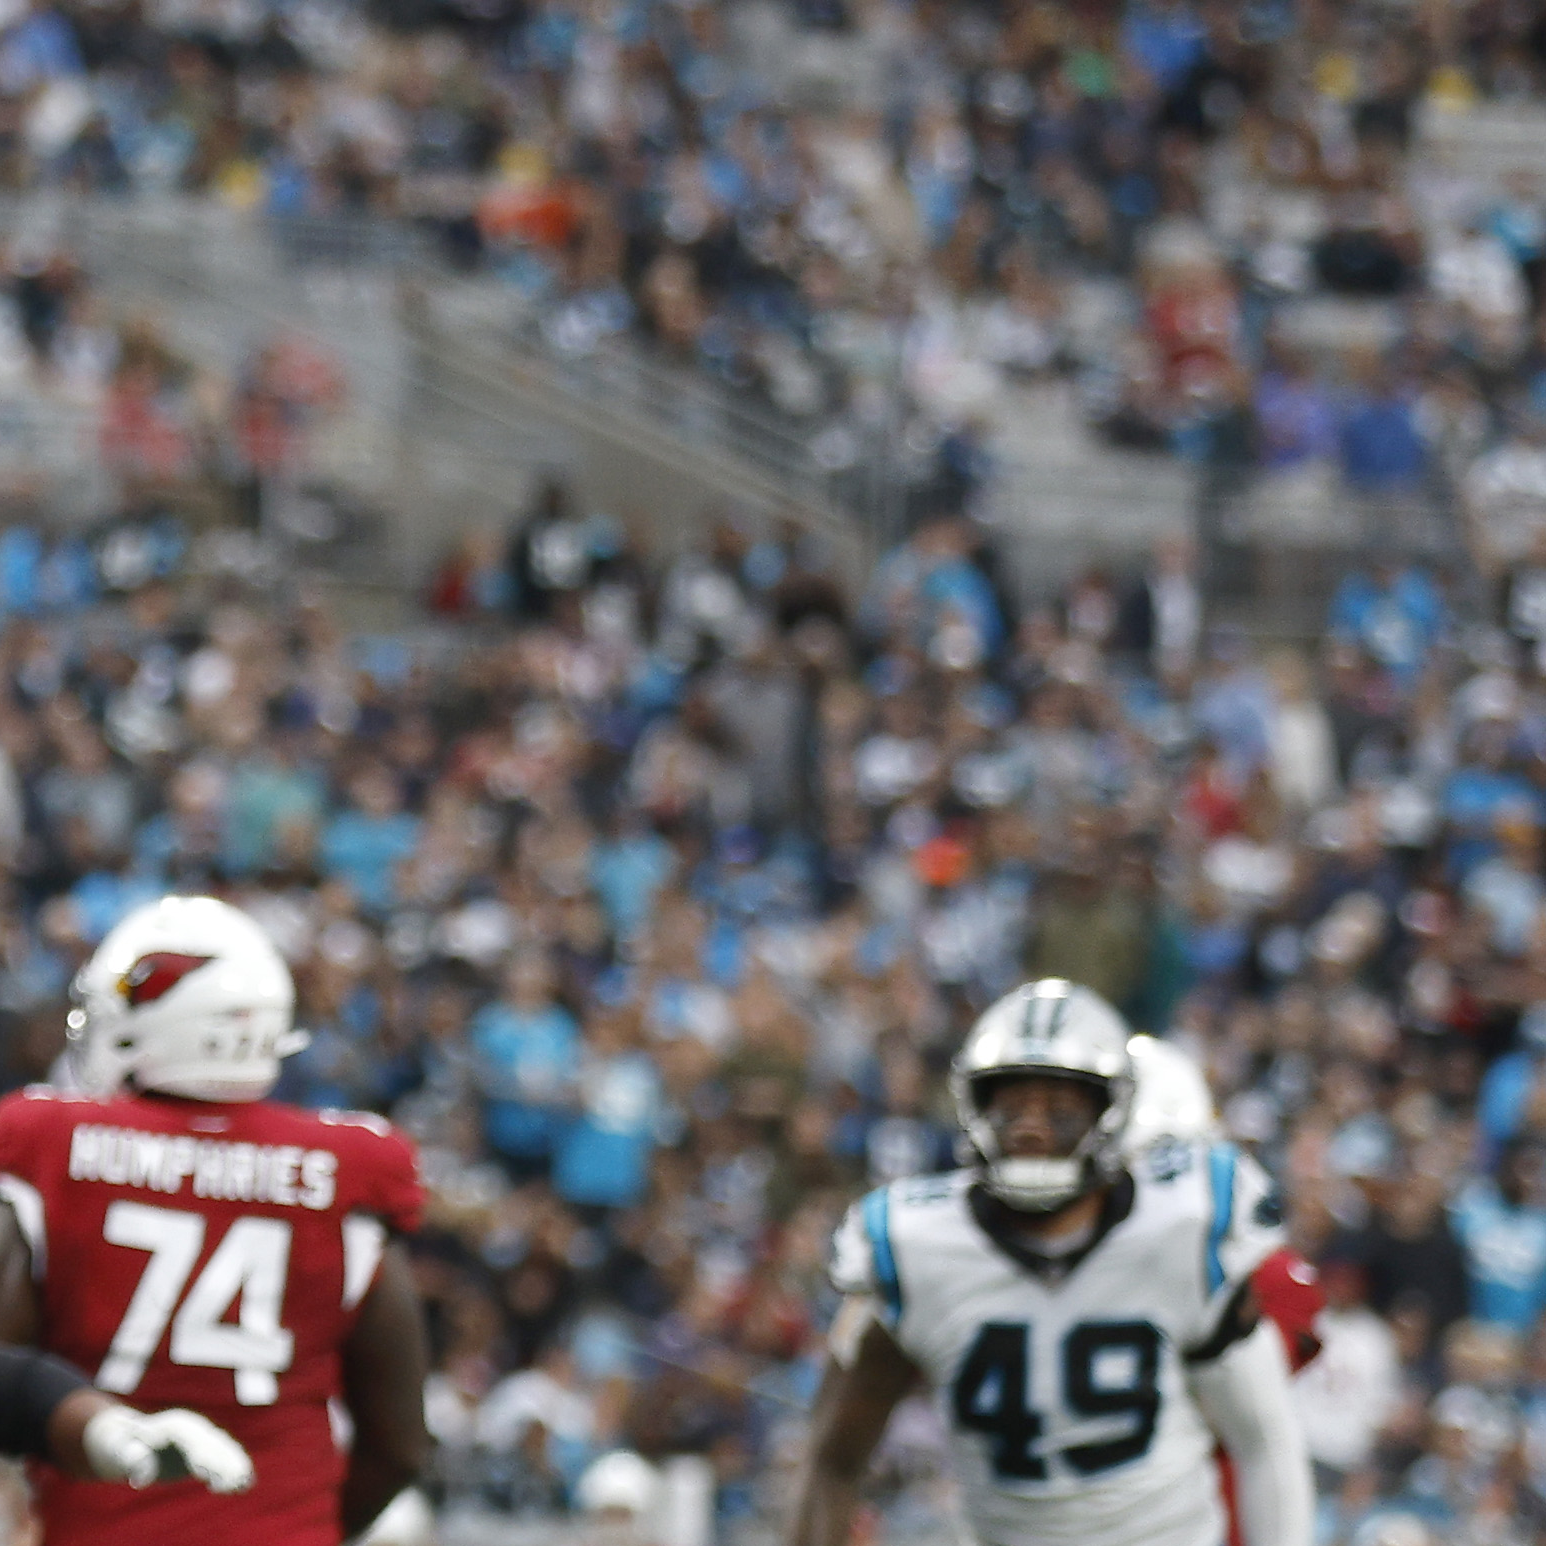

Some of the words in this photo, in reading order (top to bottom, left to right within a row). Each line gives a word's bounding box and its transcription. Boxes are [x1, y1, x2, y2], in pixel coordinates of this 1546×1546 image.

[69, 1122, 339, 1211] HUMPHRIES
[94, 1199, 295, 1406] 74
[954, 1318, 1164, 1480] 49
